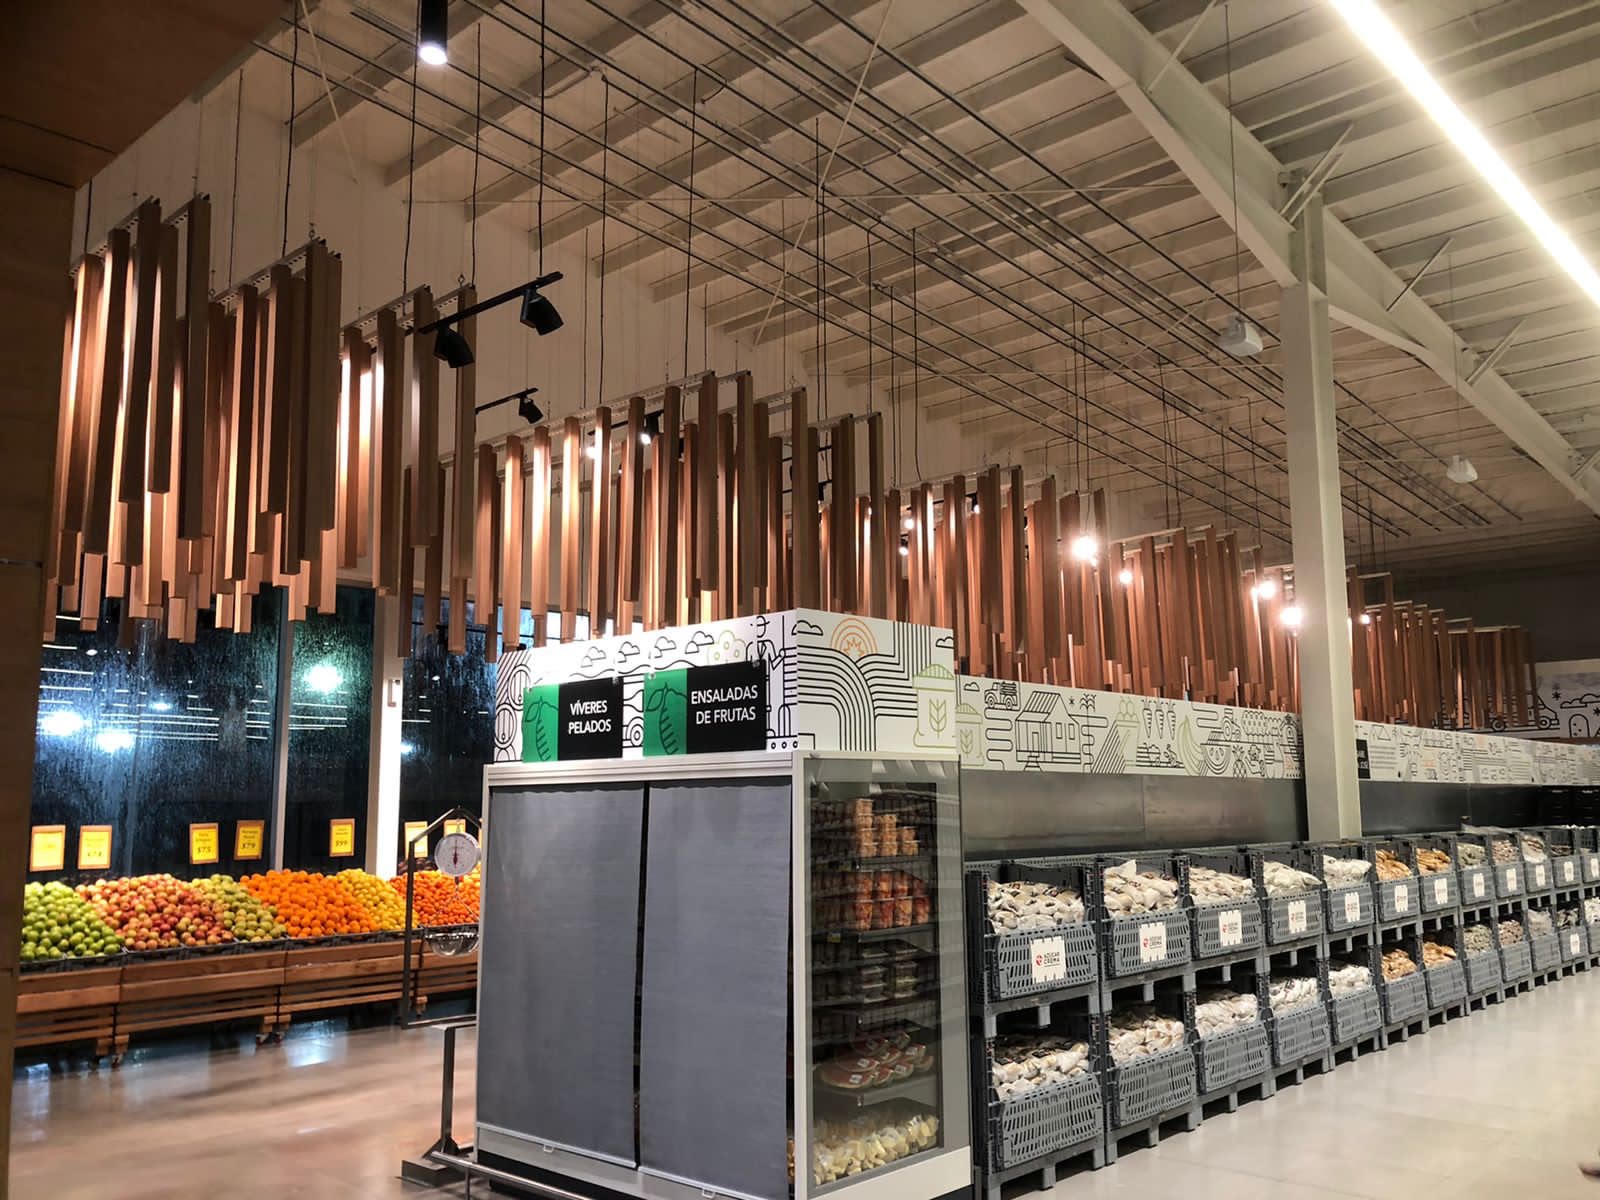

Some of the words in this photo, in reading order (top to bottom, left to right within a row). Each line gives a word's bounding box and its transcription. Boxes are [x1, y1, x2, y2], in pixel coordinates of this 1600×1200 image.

[691, 684, 758, 705] ENSALADAS
[569, 699, 608, 716] VÍVERES
[695, 709, 712, 725] DE
[713, 705, 756, 723] FRUTAS
[568, 718, 612, 735] PELADOS
